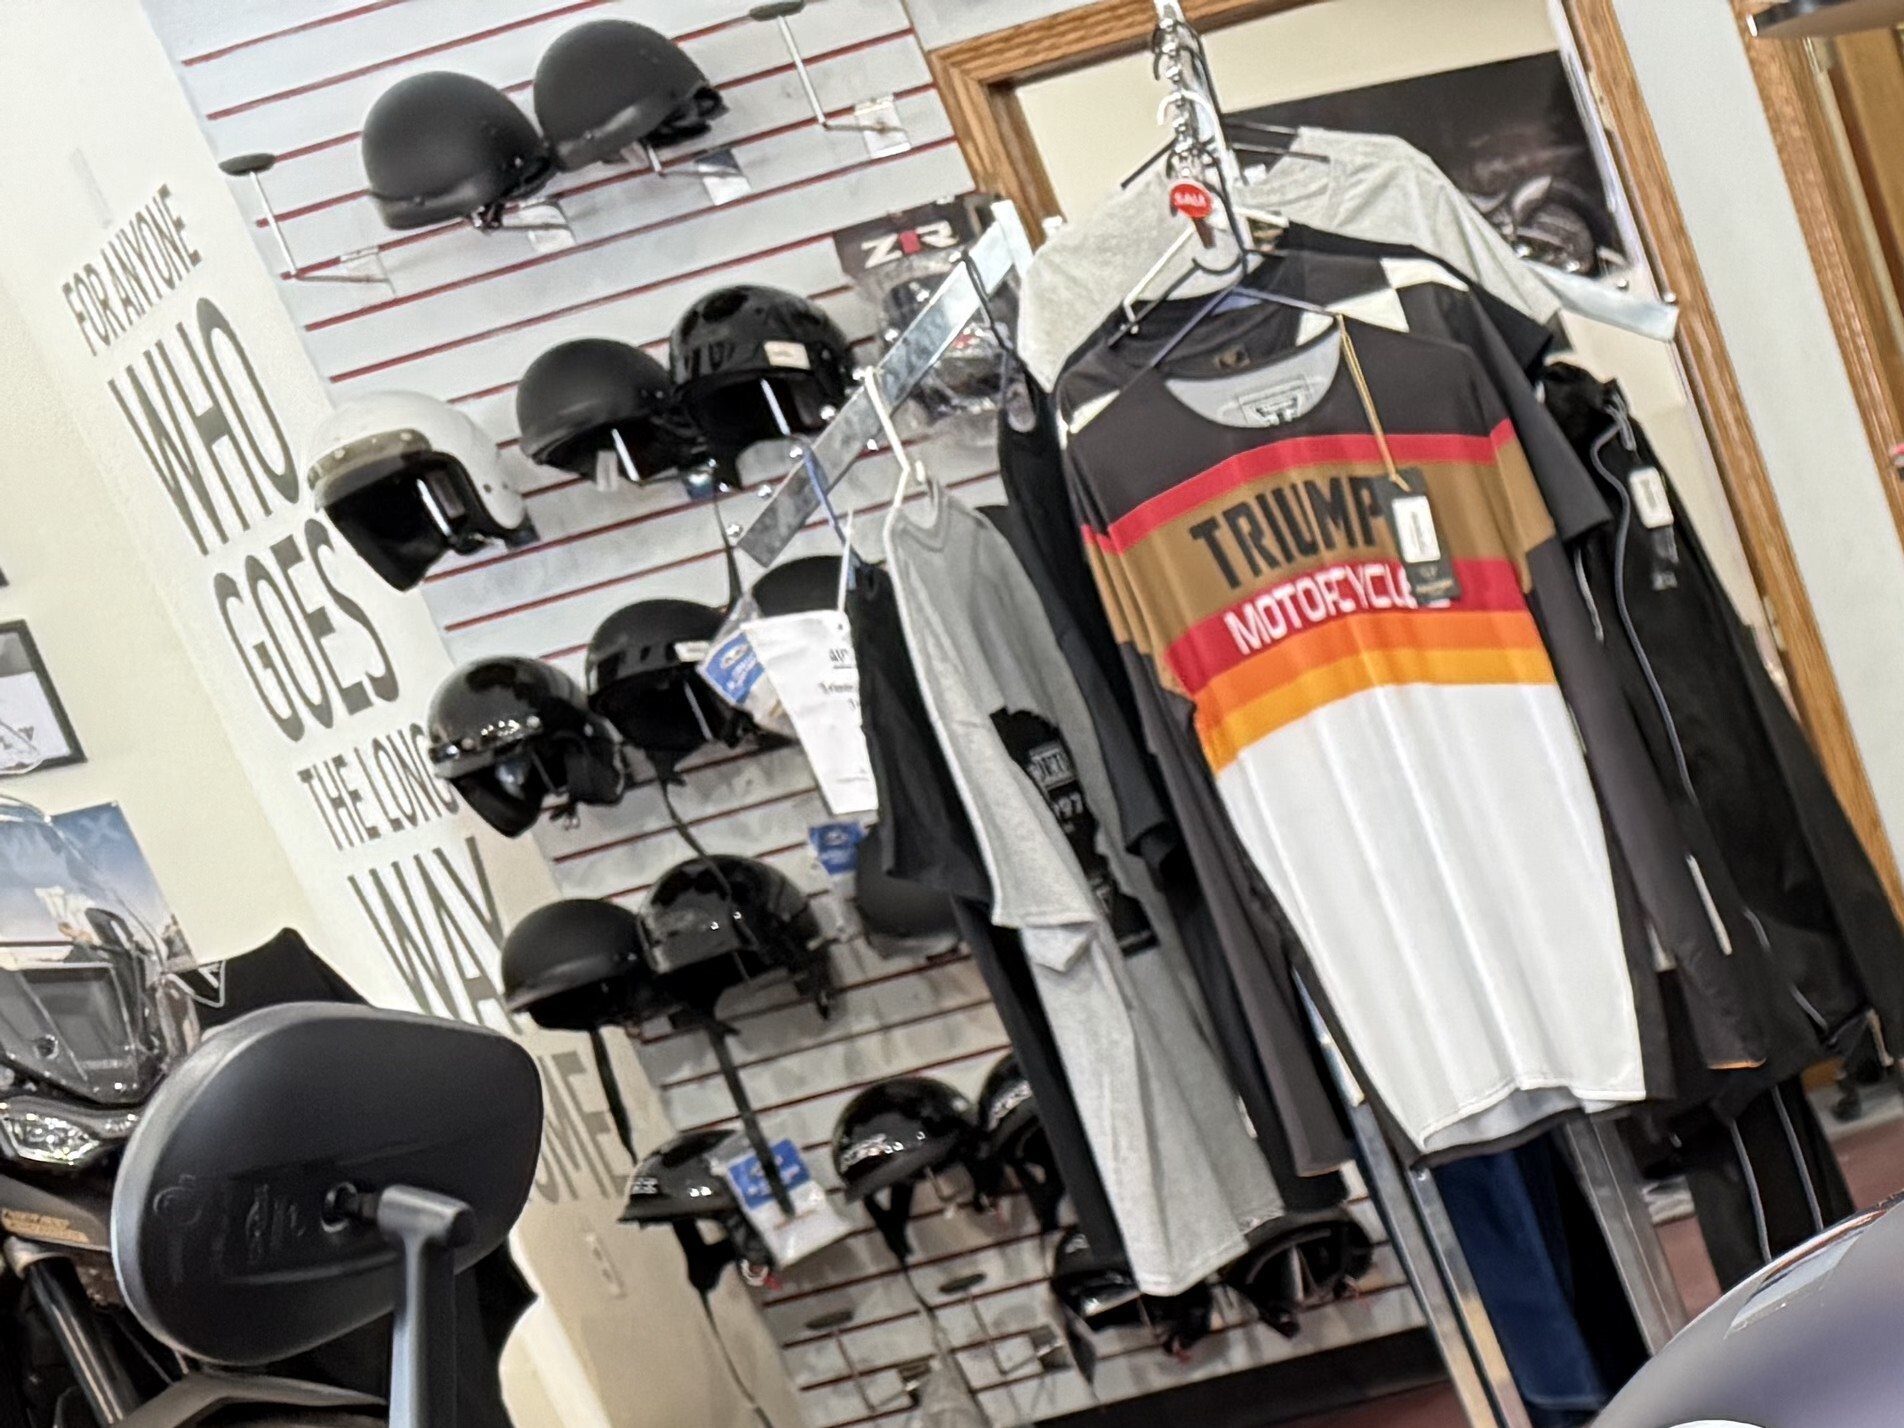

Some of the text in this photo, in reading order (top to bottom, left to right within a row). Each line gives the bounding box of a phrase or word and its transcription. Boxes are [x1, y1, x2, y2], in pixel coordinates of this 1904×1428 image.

[61, 183, 204, 357] FOR ANYONE
[107, 297, 300, 556] WHO
[1189, 475, 1387, 590] TRIUMP
[213, 518, 402, 743] GOES
[298, 753, 382, 851] THE
[347, 836, 523, 1036] WAY
